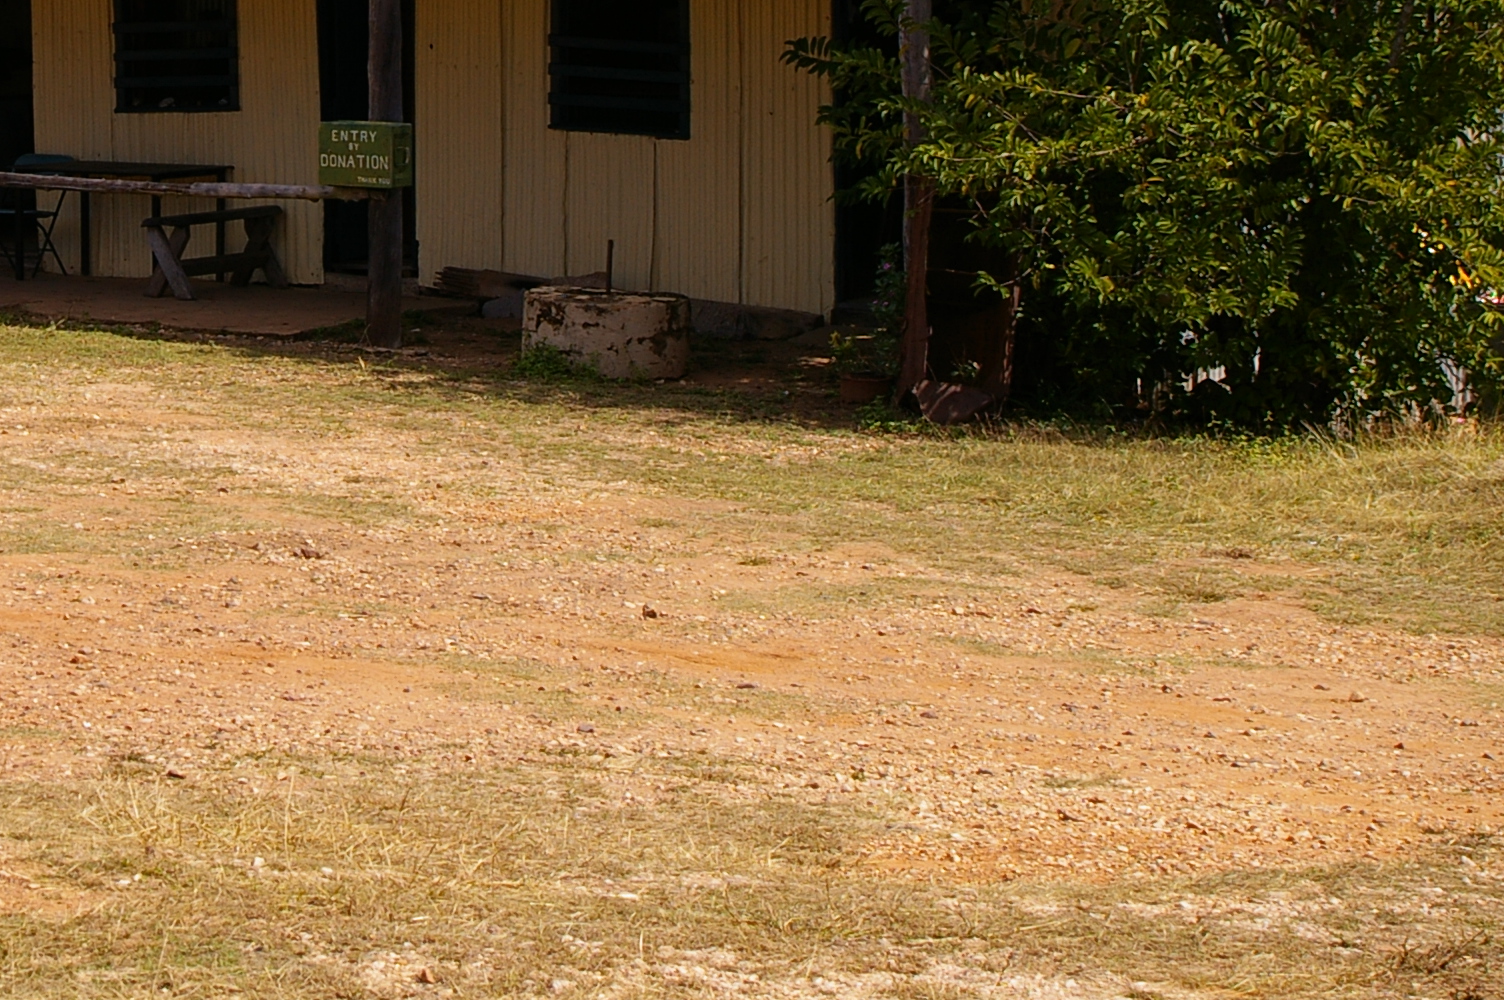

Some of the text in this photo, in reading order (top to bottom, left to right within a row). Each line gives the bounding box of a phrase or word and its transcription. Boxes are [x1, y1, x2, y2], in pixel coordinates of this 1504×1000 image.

[332, 130, 377, 142] ENTRY
[348, 143, 359, 151] BY
[320, 154, 389, 170] DONATION
